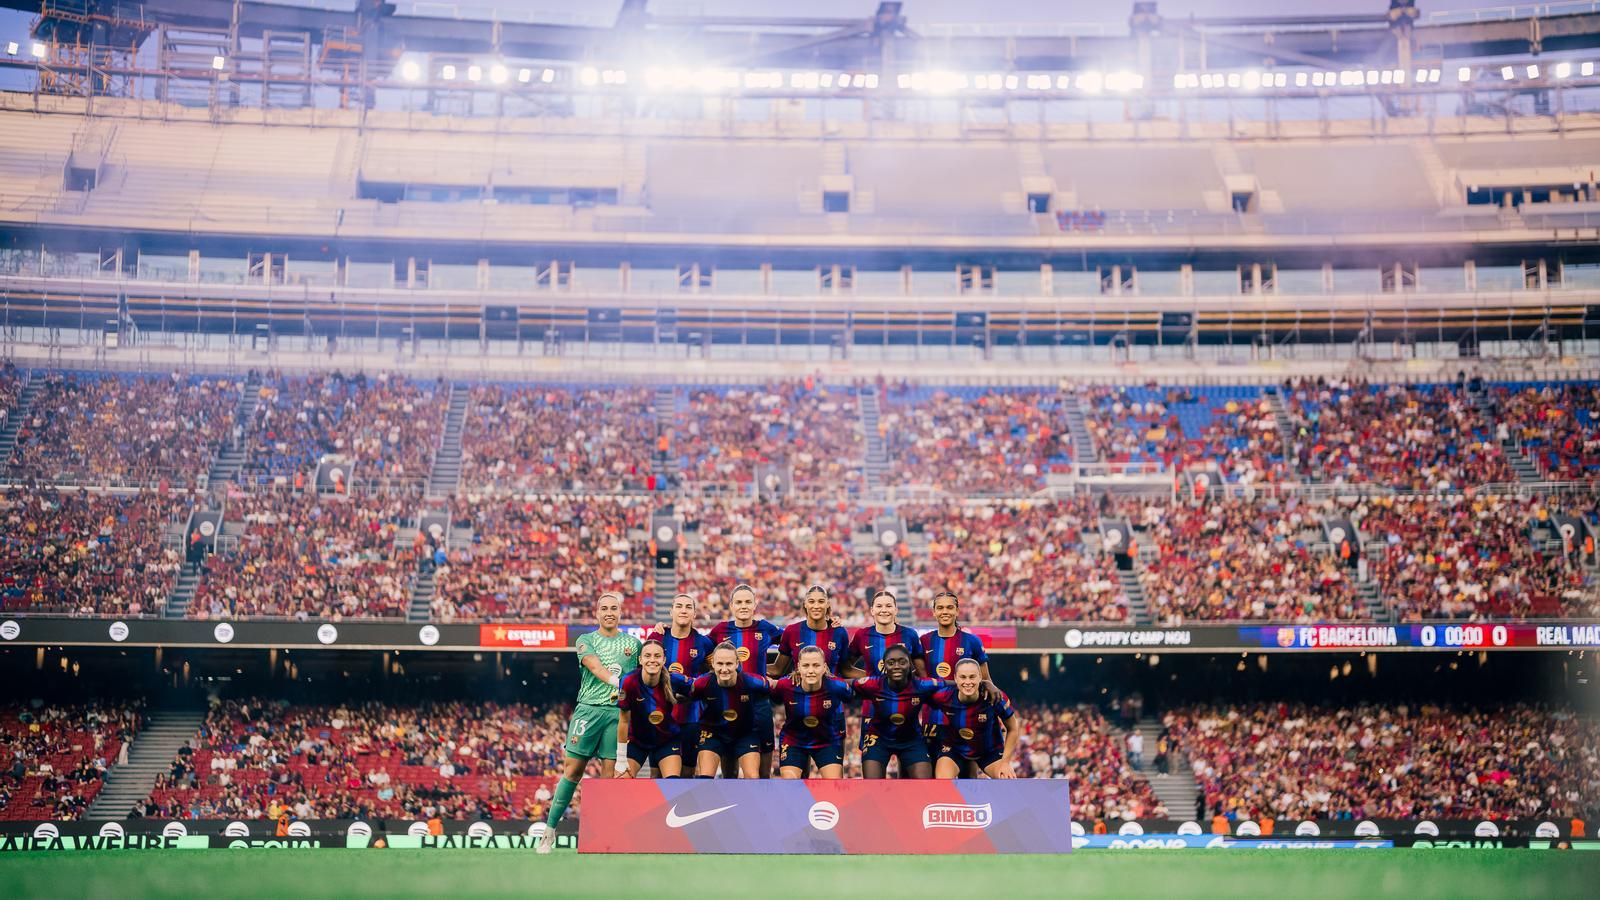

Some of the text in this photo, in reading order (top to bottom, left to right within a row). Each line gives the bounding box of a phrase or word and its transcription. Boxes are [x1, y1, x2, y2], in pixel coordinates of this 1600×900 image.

[508, 630, 555, 640] ESTRELLA
[1082, 631, 1190, 645] SPOTIFY CAMP NOU
[1299, 627, 1317, 646] FC
[1318, 627, 1397, 646] BARCELONA
[1421, 626, 1436, 646] 0
[1445, 627, 1483, 645] 00:00
[1492, 626, 1507, 646] 0
[1536, 627, 1570, 645] REAL
[573, 719, 588, 736] 13
[928, 810, 987, 822] BIMBO
